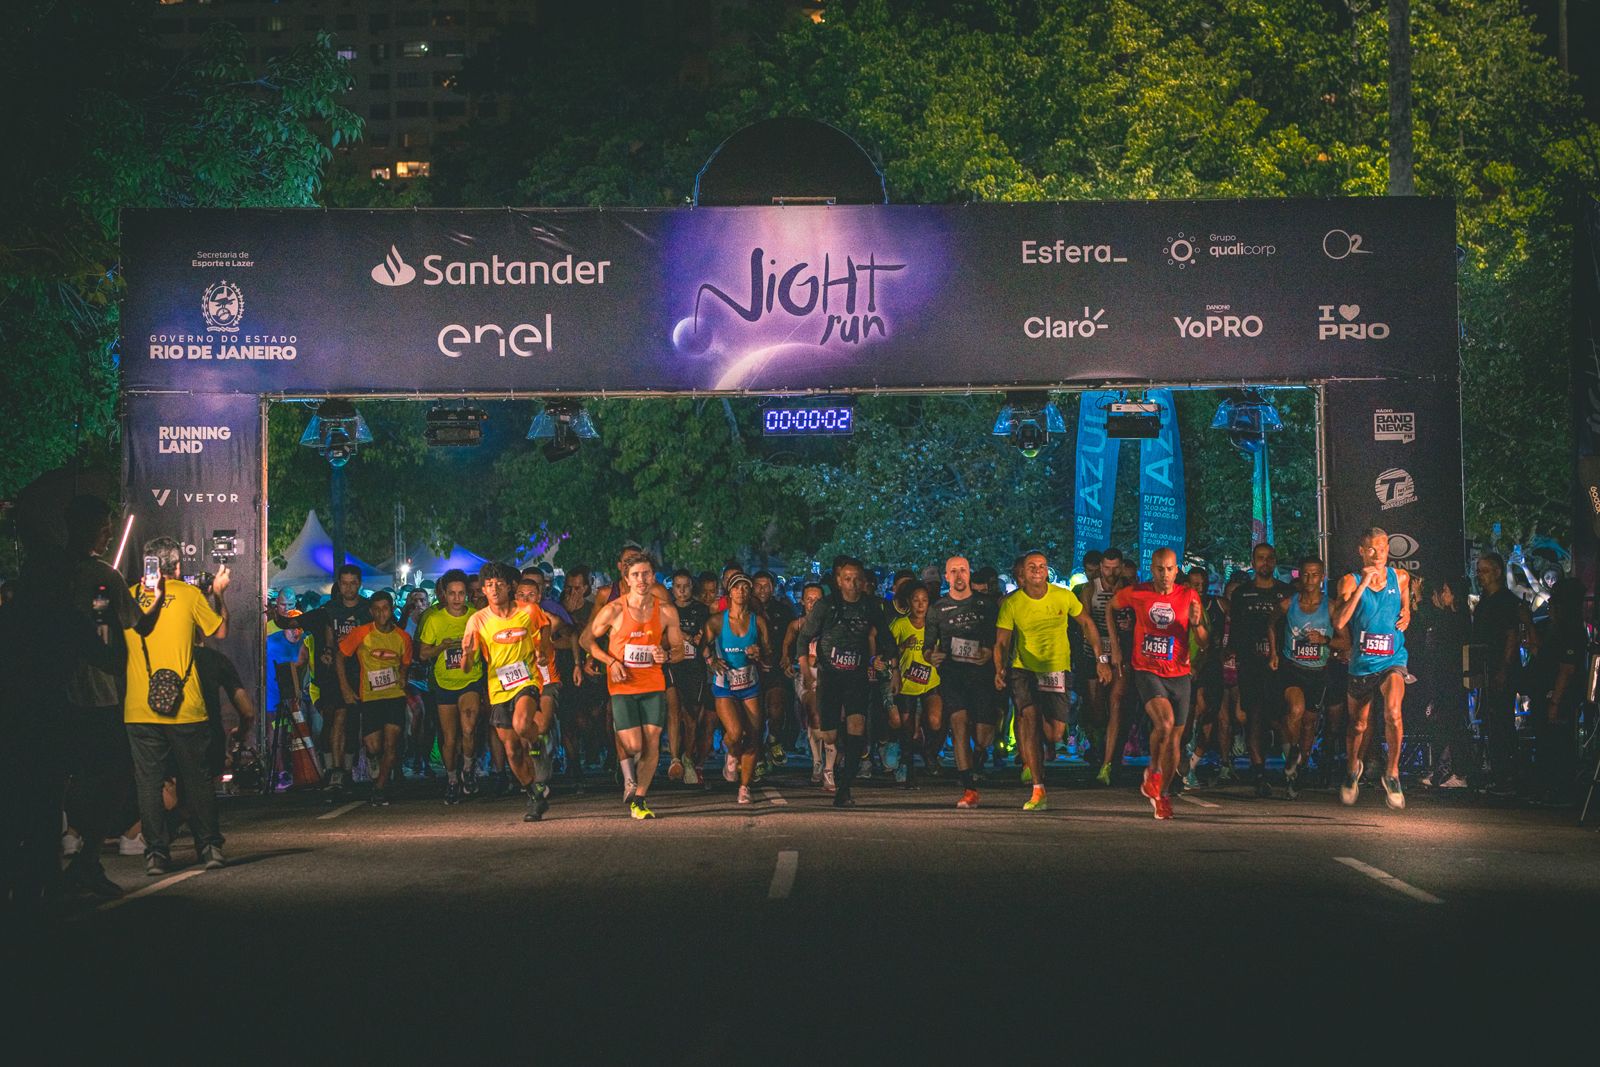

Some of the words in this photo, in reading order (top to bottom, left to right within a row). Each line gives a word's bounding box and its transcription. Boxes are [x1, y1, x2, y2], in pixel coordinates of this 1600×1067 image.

[1209, 233, 1236, 243] Grupo
[196, 251, 239, 260] Secretaria
[240, 251, 249, 260] de
[1209, 242, 1276, 258] qualicorp
[191, 260, 224, 270] Esporte
[225, 261, 231, 269] e
[232, 260, 255, 269] Lazer
[423, 254, 611, 286] Santander
[1318, 305, 1335, 322] I
[820, 314, 886, 346] run
[1023, 309, 1105, 339] Claro
[1173, 315, 1263, 338] YoPRO
[437, 313, 552, 357] enel
[1319, 323, 1390, 340] PRIO
[150, 335, 214, 343] GOVERNO
[221, 335, 238, 343] DO
[245, 335, 297, 343] ESTADO
[150, 345, 185, 360] RIO
[187, 345, 212, 360] DE
[216, 345, 297, 360] JANEIRO
[766, 409, 850, 430] 00:00:02
[1376, 415, 1413, 423] BAND
[159, 426, 232, 440] RUNNING
[1376, 423, 1413, 432] NEWS
[159, 440, 204, 454] LAND
[184, 493, 239, 503] VETOR
[1143, 495, 1176, 506] RITMO
[1388, 560, 1421, 571] AND
[1145, 640, 1168, 654] 14356
[1297, 646, 1318, 656] 14995
[629, 651, 648, 661] 4461
[505, 668, 523, 683] 6291
